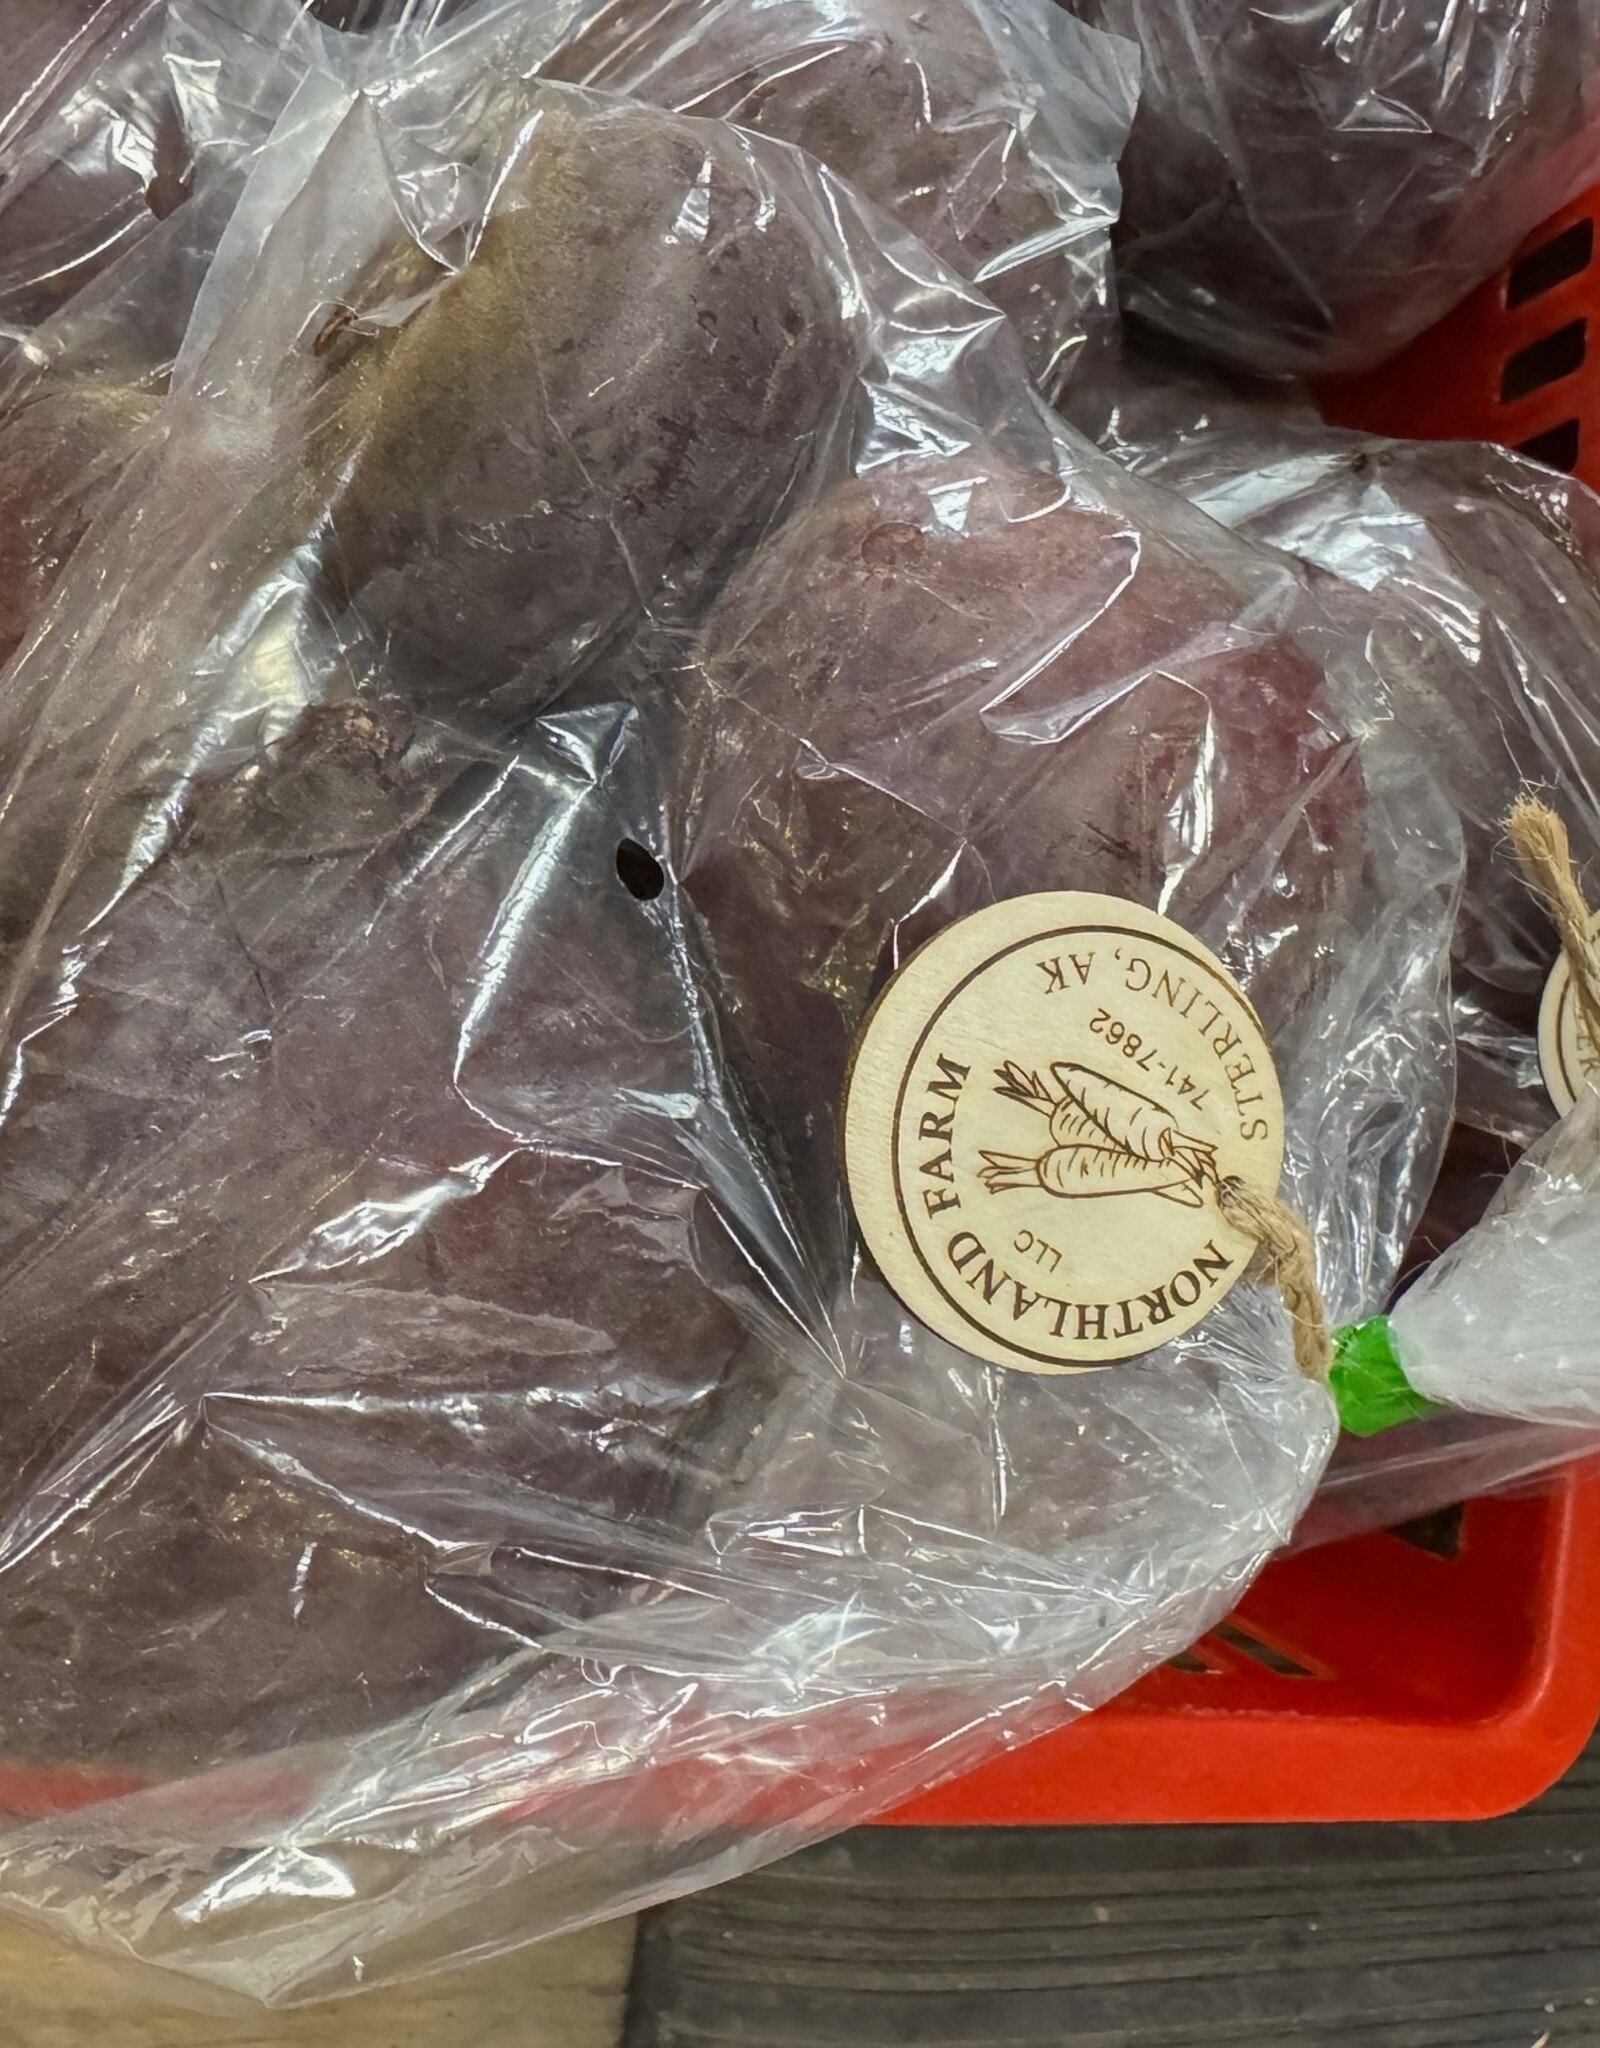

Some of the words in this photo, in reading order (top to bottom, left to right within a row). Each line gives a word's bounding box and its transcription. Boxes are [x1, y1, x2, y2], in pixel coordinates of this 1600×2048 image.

[1036, 952, 1097, 995] AK
[1089, 1007, 1209, 1111] 741-7862
[1113, 949, 1269, 1141] STERLING,
[918, 1053, 972, 1219] FARM
[947, 1231, 1234, 1340] NORTHLAND
[1013, 1229, 1063, 1273] LLC
